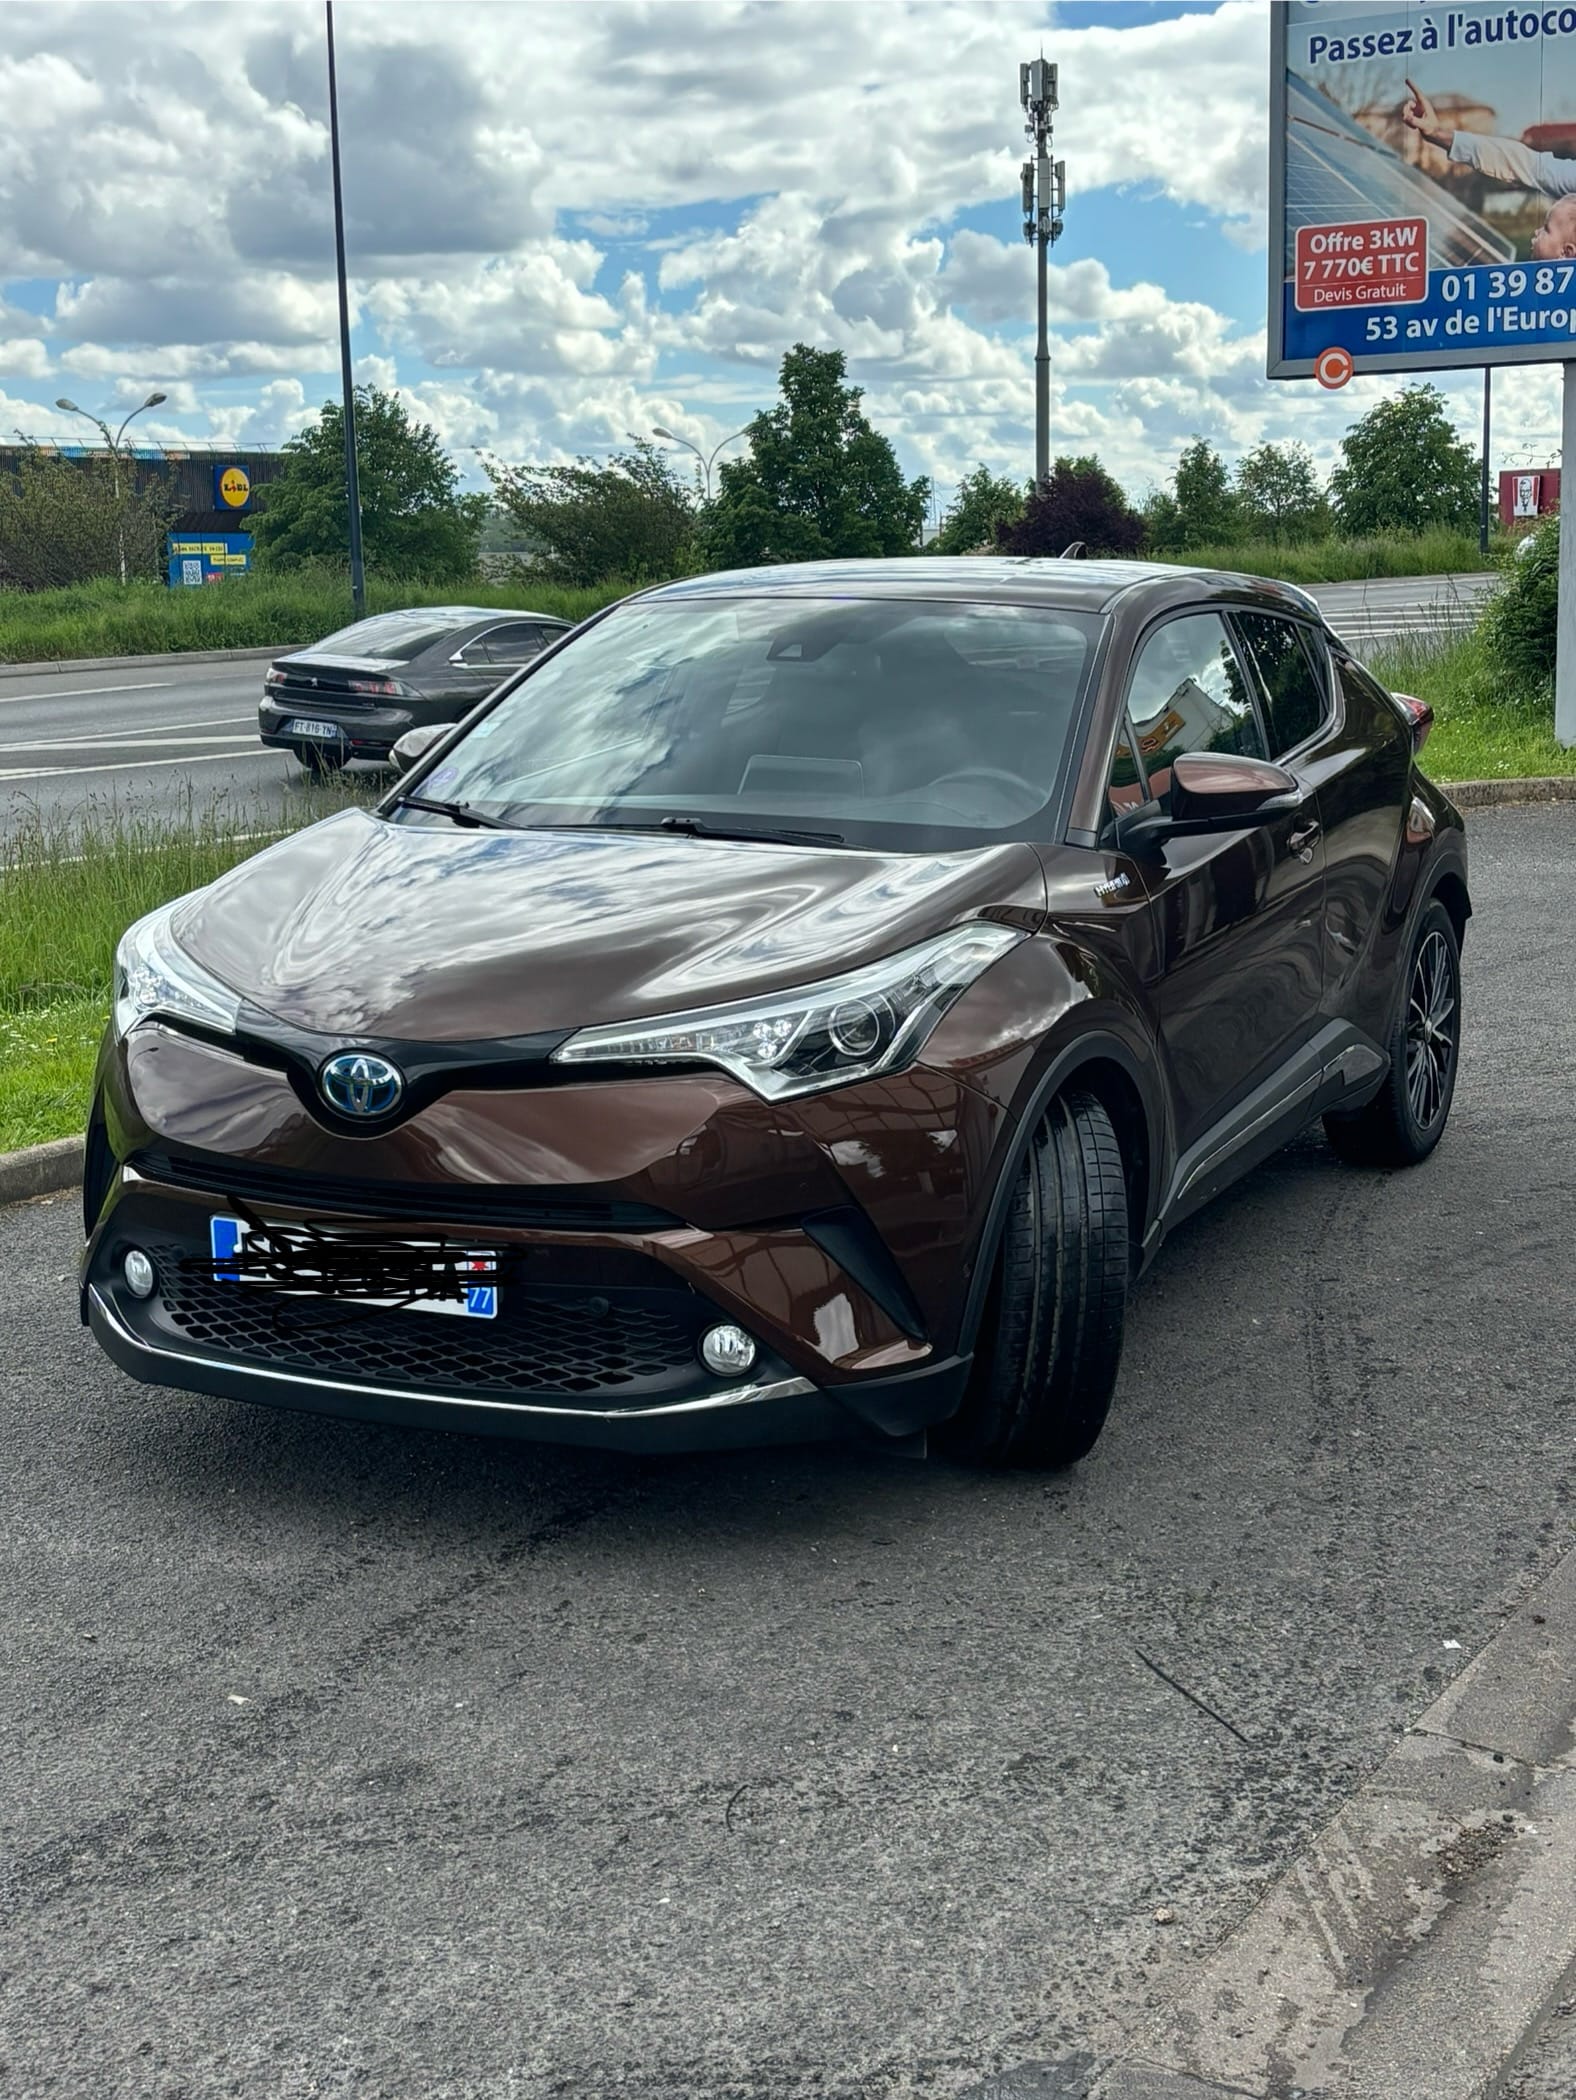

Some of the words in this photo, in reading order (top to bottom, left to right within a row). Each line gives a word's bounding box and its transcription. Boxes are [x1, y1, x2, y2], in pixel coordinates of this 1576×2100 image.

[1310, 29, 1413, 64] Passez
[1421, 18, 1438, 50] à
[1448, 8, 1576, 47] l'autoco
[1310, 231, 1364, 254] Offre
[1369, 226, 1418, 249] 3kW
[1303, 261, 1316, 280] 7
[1321, 256, 1374, 279] 770€
[1377, 252, 1419, 274] TTC
[1313, 287, 1353, 303] Devis
[1355, 283, 1406, 300] Gratuit
[1441, 273, 1476, 302] 01
[1488, 269, 1528, 298] 39
[1534, 266, 1575, 295] 87
[1365, 316, 1398, 341] 53
[1406, 318, 1438, 339] av
[1445, 309, 1480, 336] de
[470, 1286, 491, 1309] 77
